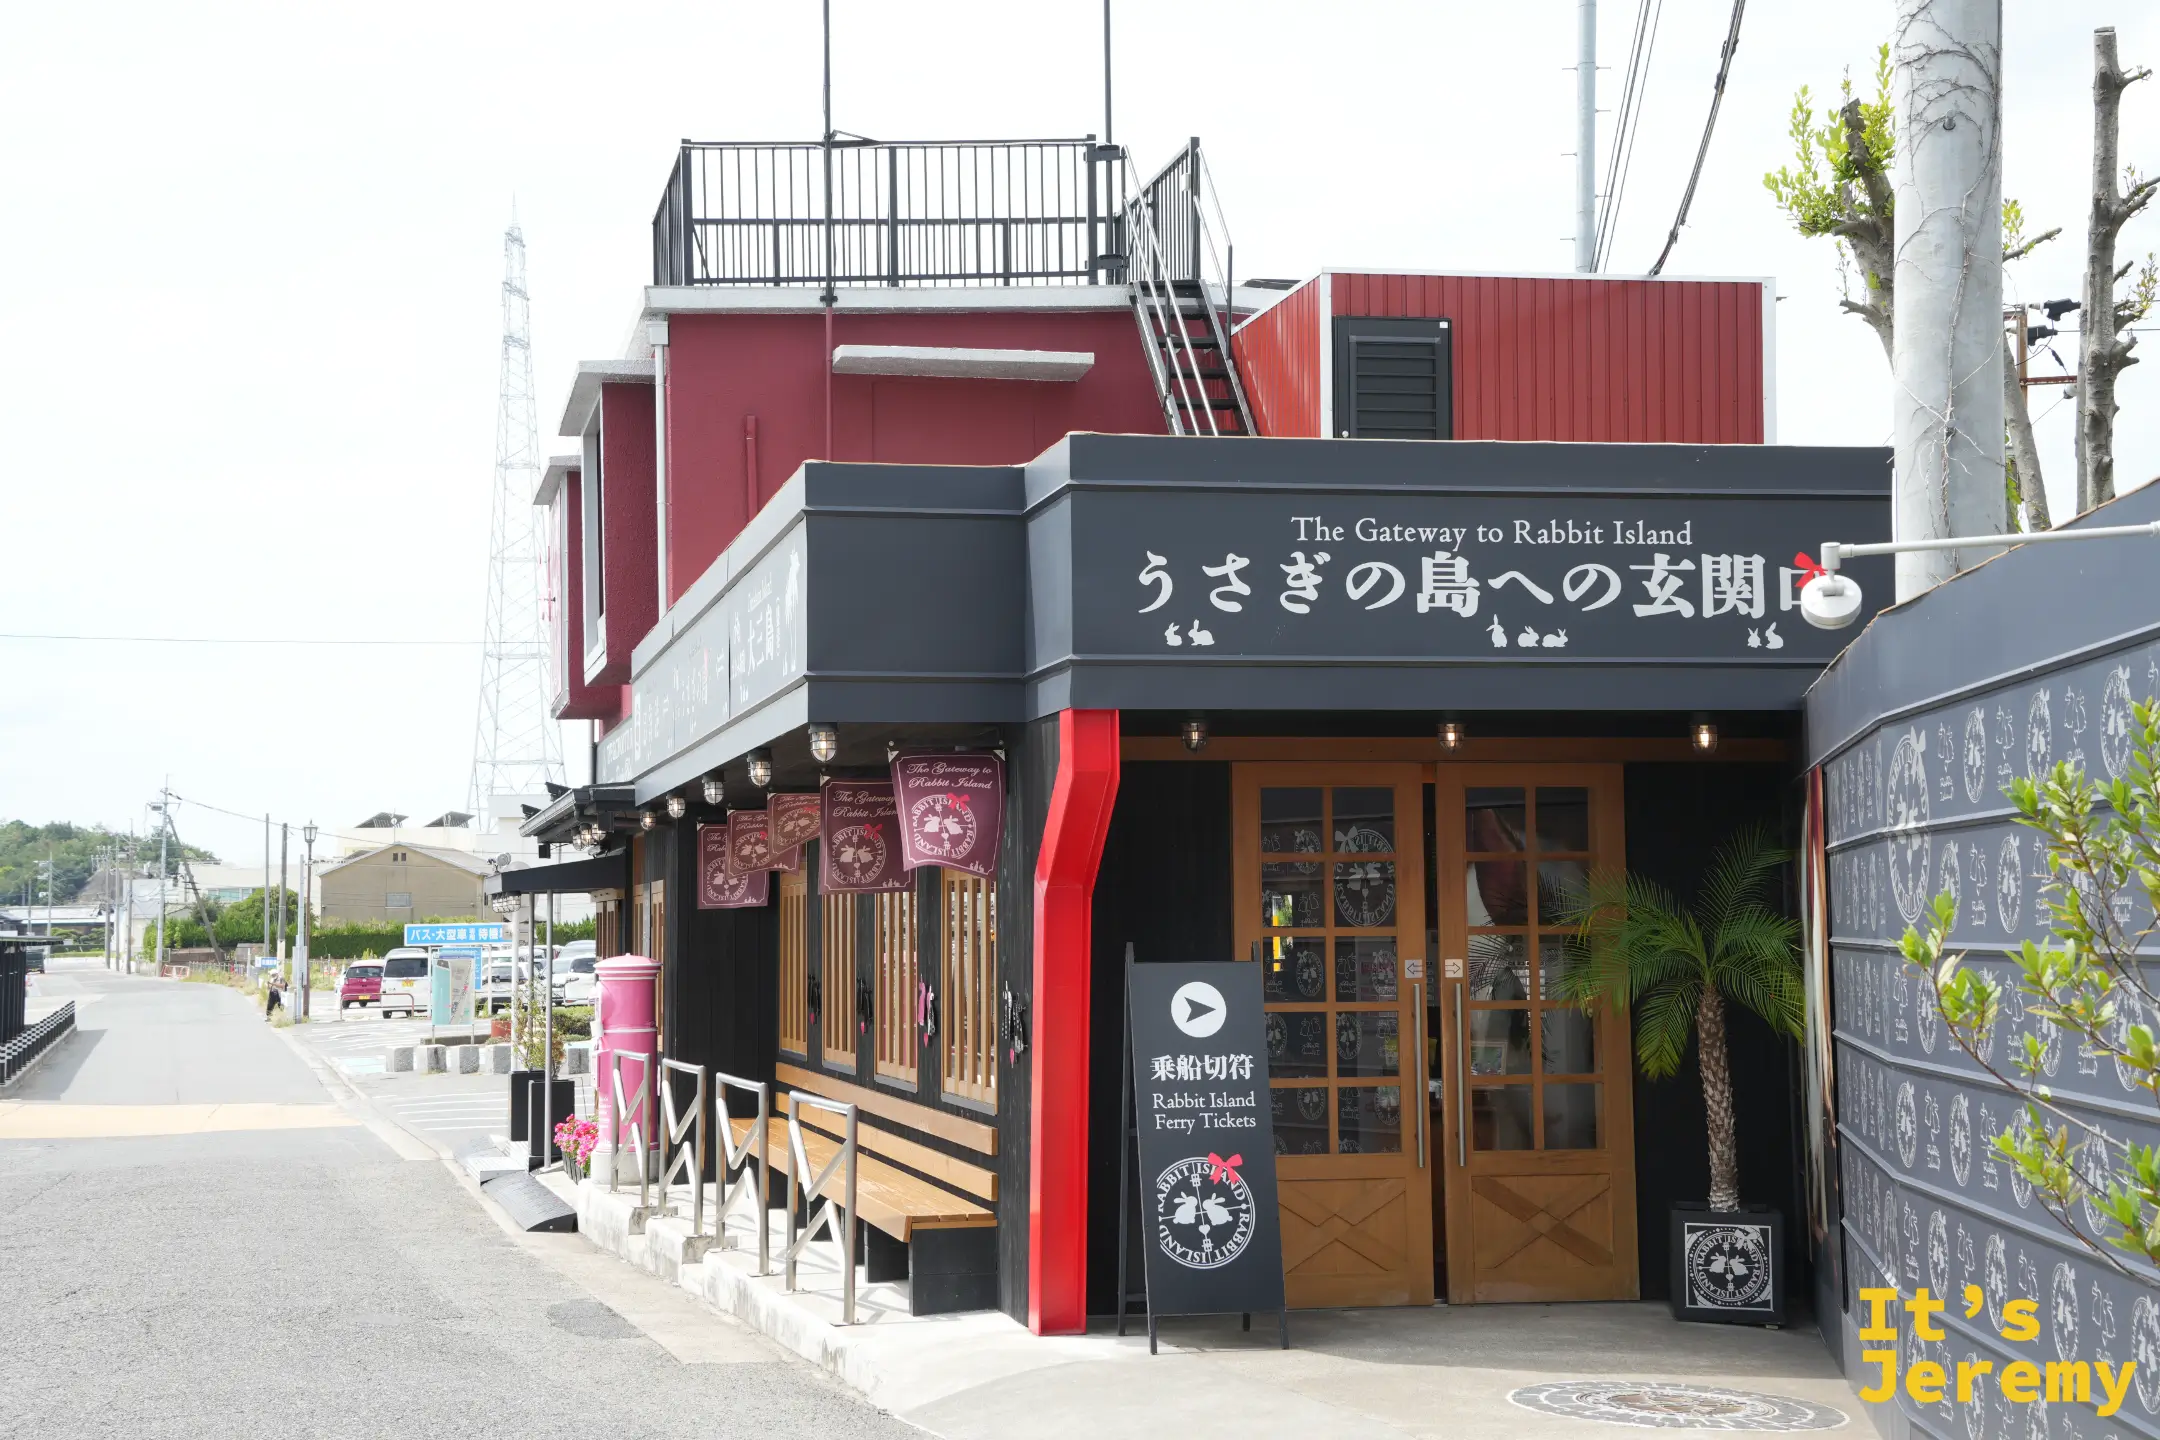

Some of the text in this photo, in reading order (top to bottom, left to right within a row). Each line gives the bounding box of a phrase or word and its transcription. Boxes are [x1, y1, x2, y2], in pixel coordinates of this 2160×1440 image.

[1290, 515, 1693, 552] The Gateway to Rabbit Island
[907, 761, 992, 777] The Gateway to
[908, 776, 992, 789] Rabbit Island
[833, 790, 854, 802] The
[832, 806, 899, 818] Rabbit Islan
[1149, 1053, 1254, 1082] 乗船切符
[1152, 1091, 1256, 1109] Rabbit Island
[1154, 1111, 1256, 1135] Ferry Tickets
[1213, 1212, 1251, 1263] RABBIT
[1697, 1235, 1723, 1265] RABBIT
